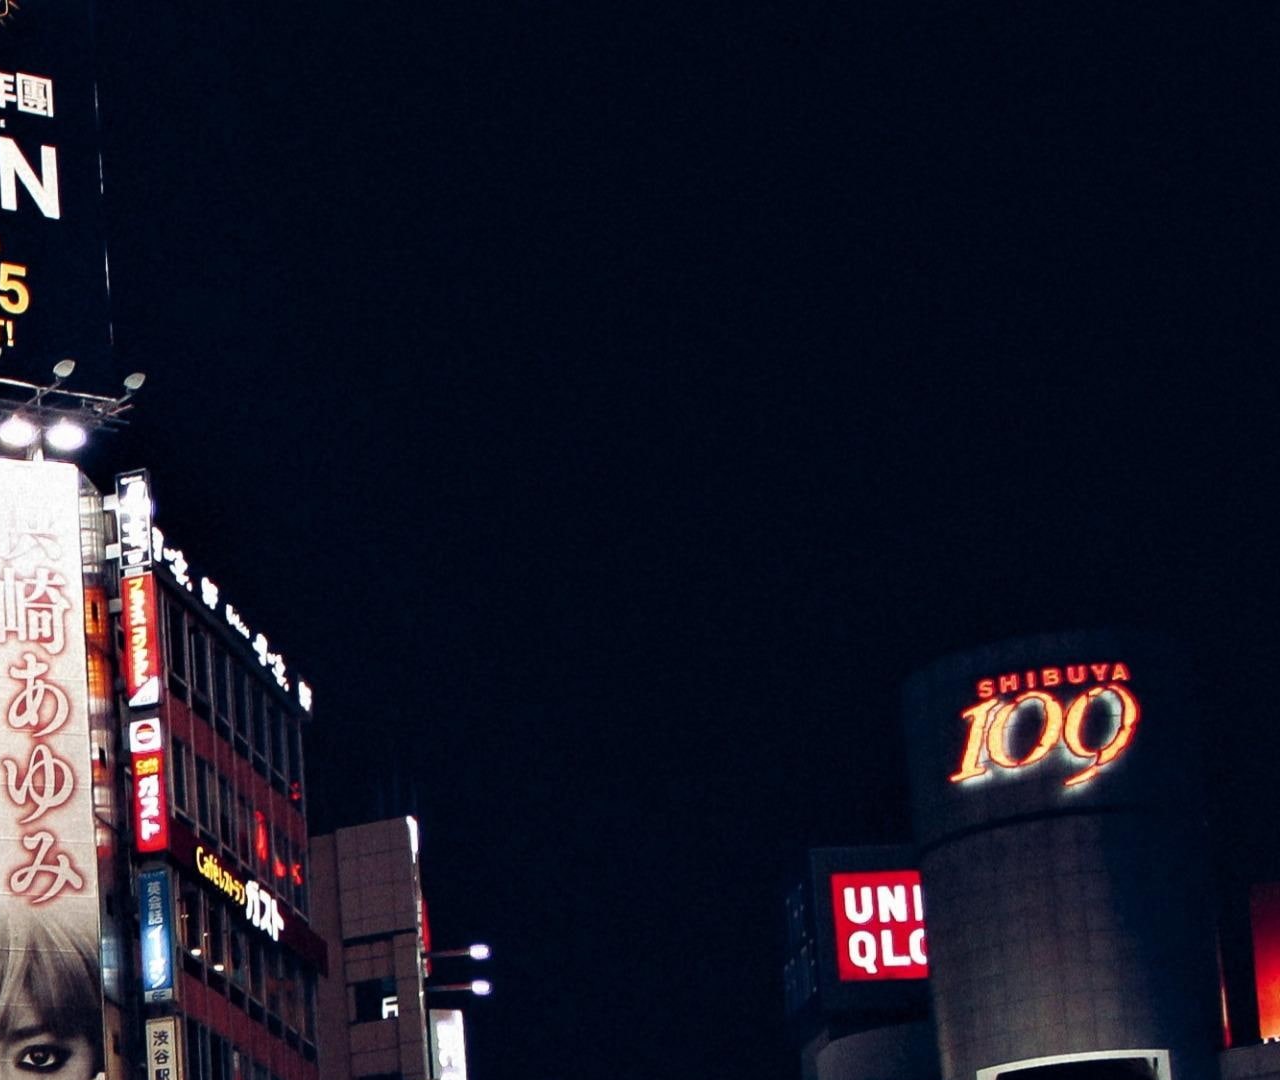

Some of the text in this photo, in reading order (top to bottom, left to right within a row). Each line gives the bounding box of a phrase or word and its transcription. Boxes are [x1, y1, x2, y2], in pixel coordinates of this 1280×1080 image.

[977, 661, 1131, 698] SHIBUYA
[950, 684, 1139, 788] 109
[137, 774, 161, 842] ガスト
[844, 885, 924, 925] UNI
